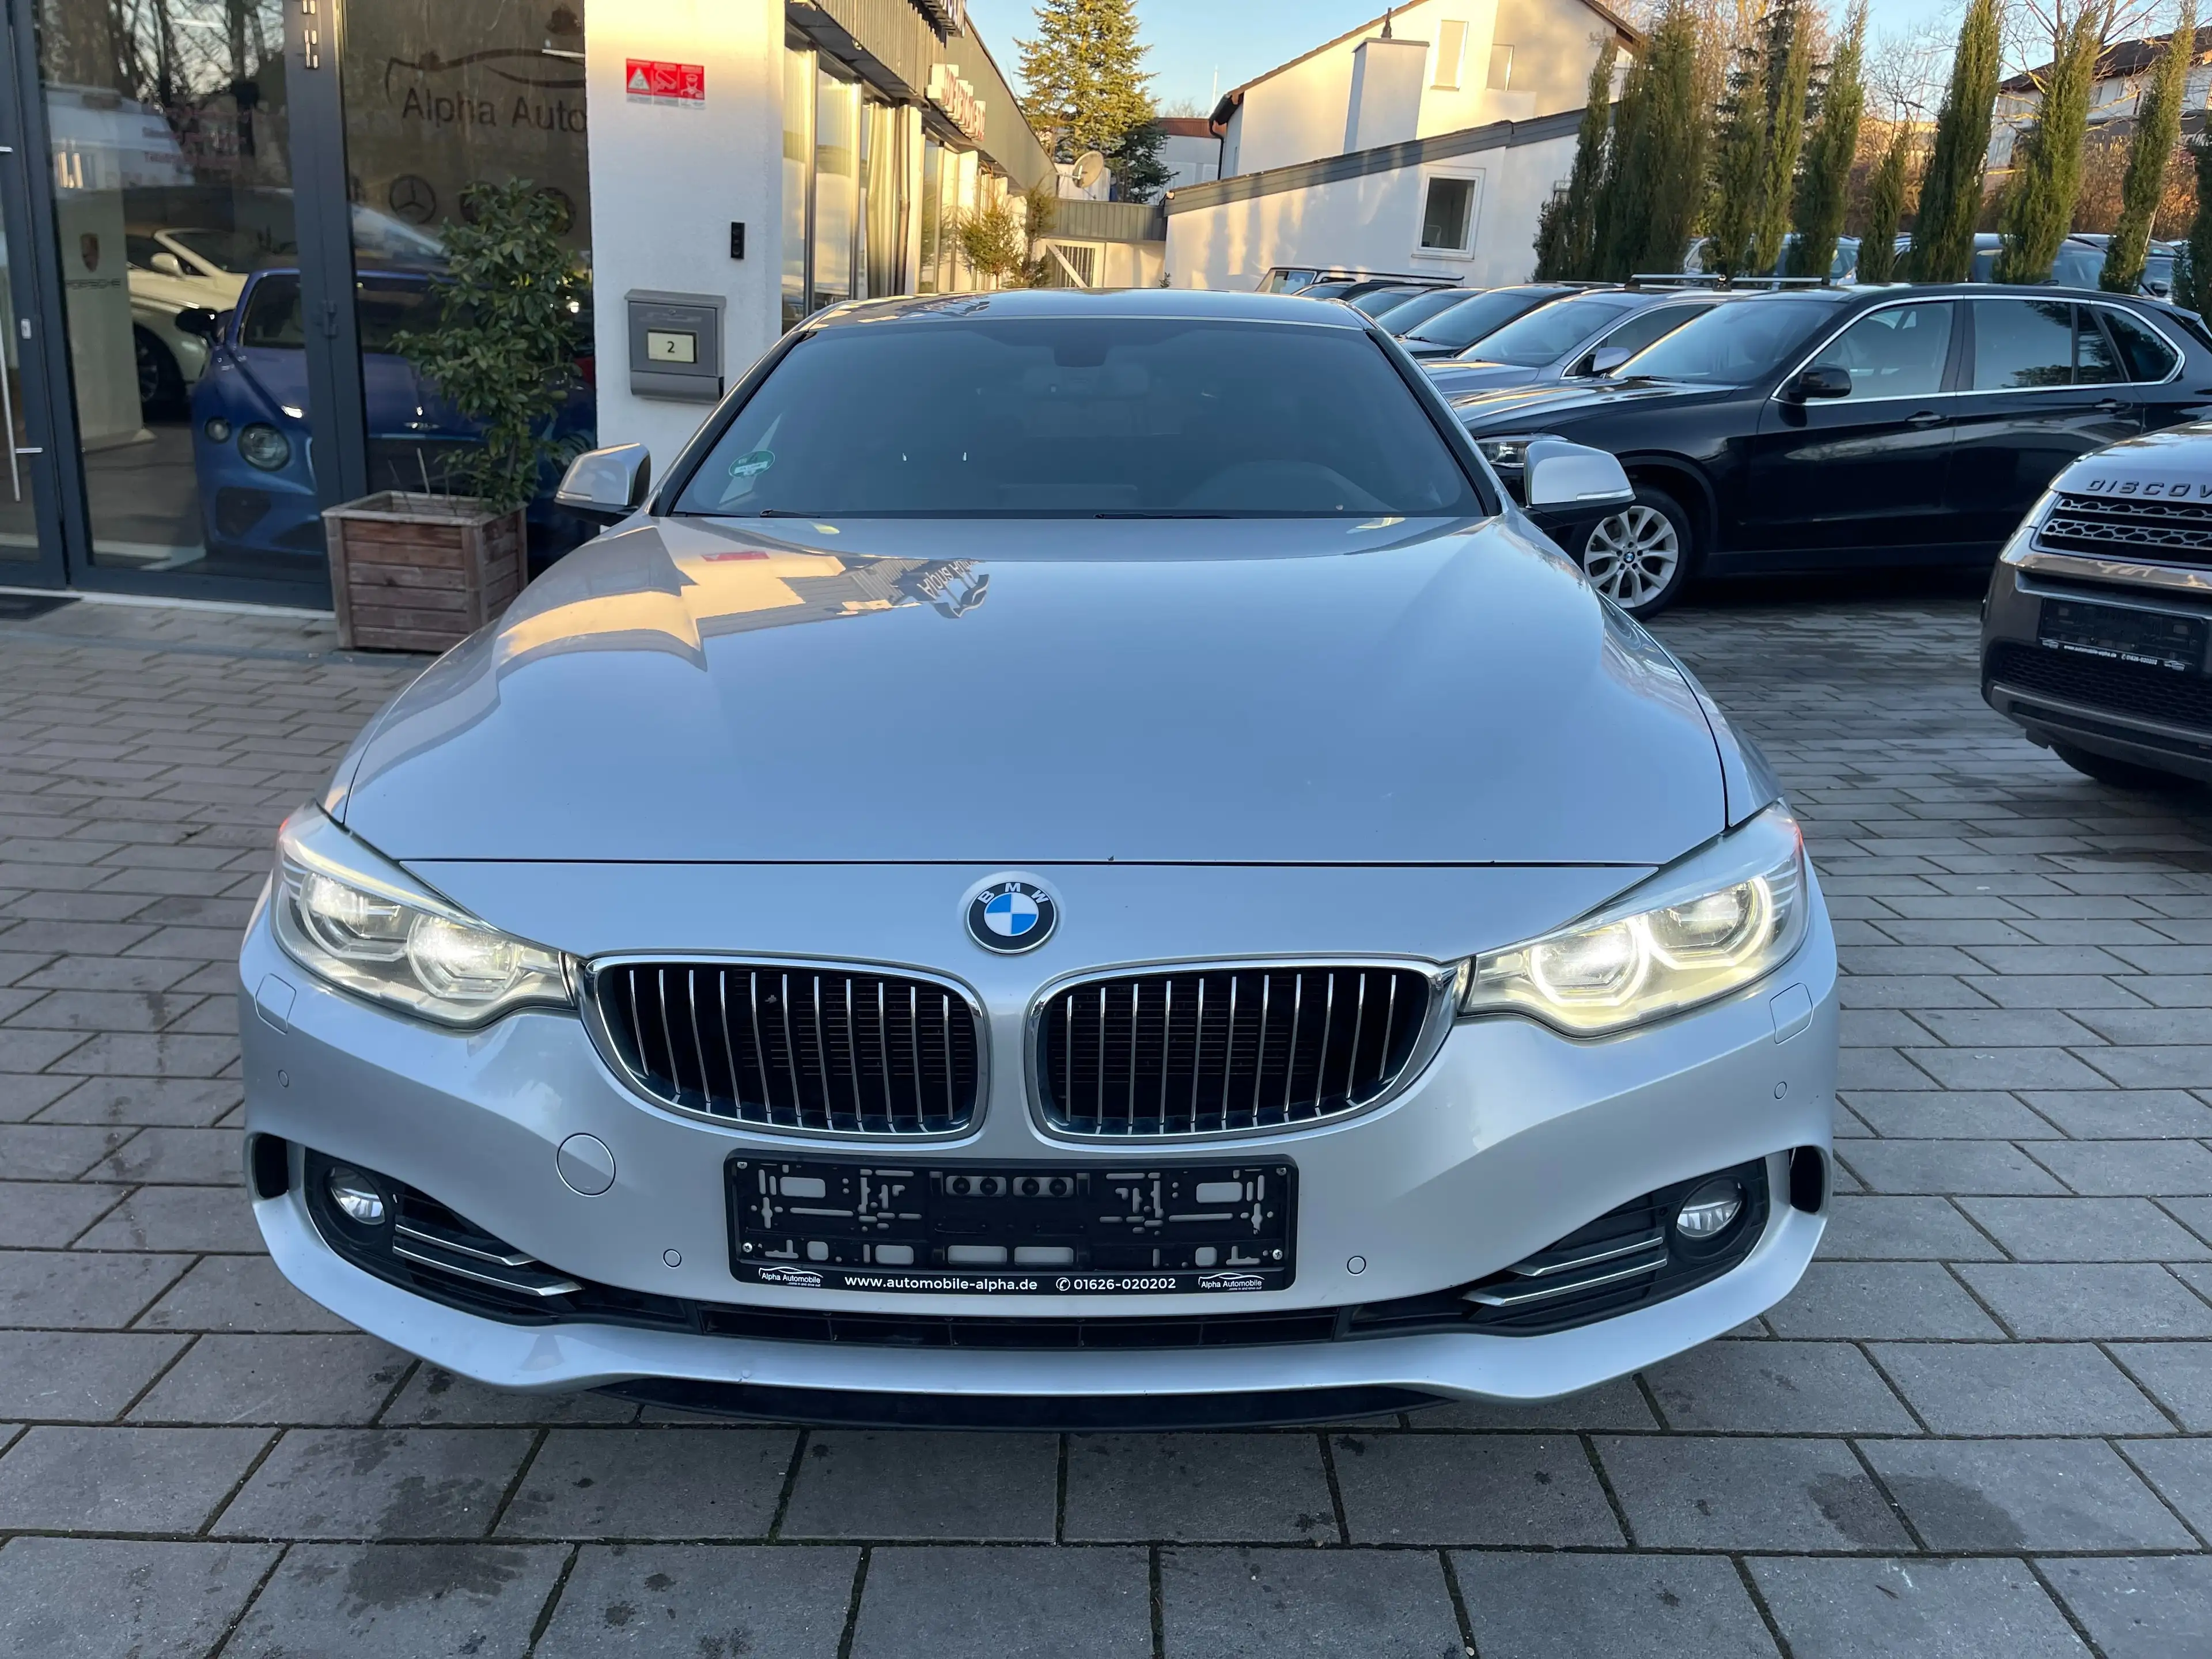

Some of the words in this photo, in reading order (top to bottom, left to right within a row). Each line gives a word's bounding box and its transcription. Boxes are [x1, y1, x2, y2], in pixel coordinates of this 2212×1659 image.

[403, 88, 497, 127] Alpha
[667, 341, 675, 353] 2
[978, 882, 1049, 904] BMW
[762, 1272, 781, 1281] Alpha
[782, 1274, 821, 1283] Automobile
[844, 1277, 1037, 1291] www.automobile-alpha.de
[1074, 1278, 1176, 1290] 01626-020202
[1201, 1281, 1221, 1289] Alpha
[1222, 1279, 1262, 1287] Automobile
